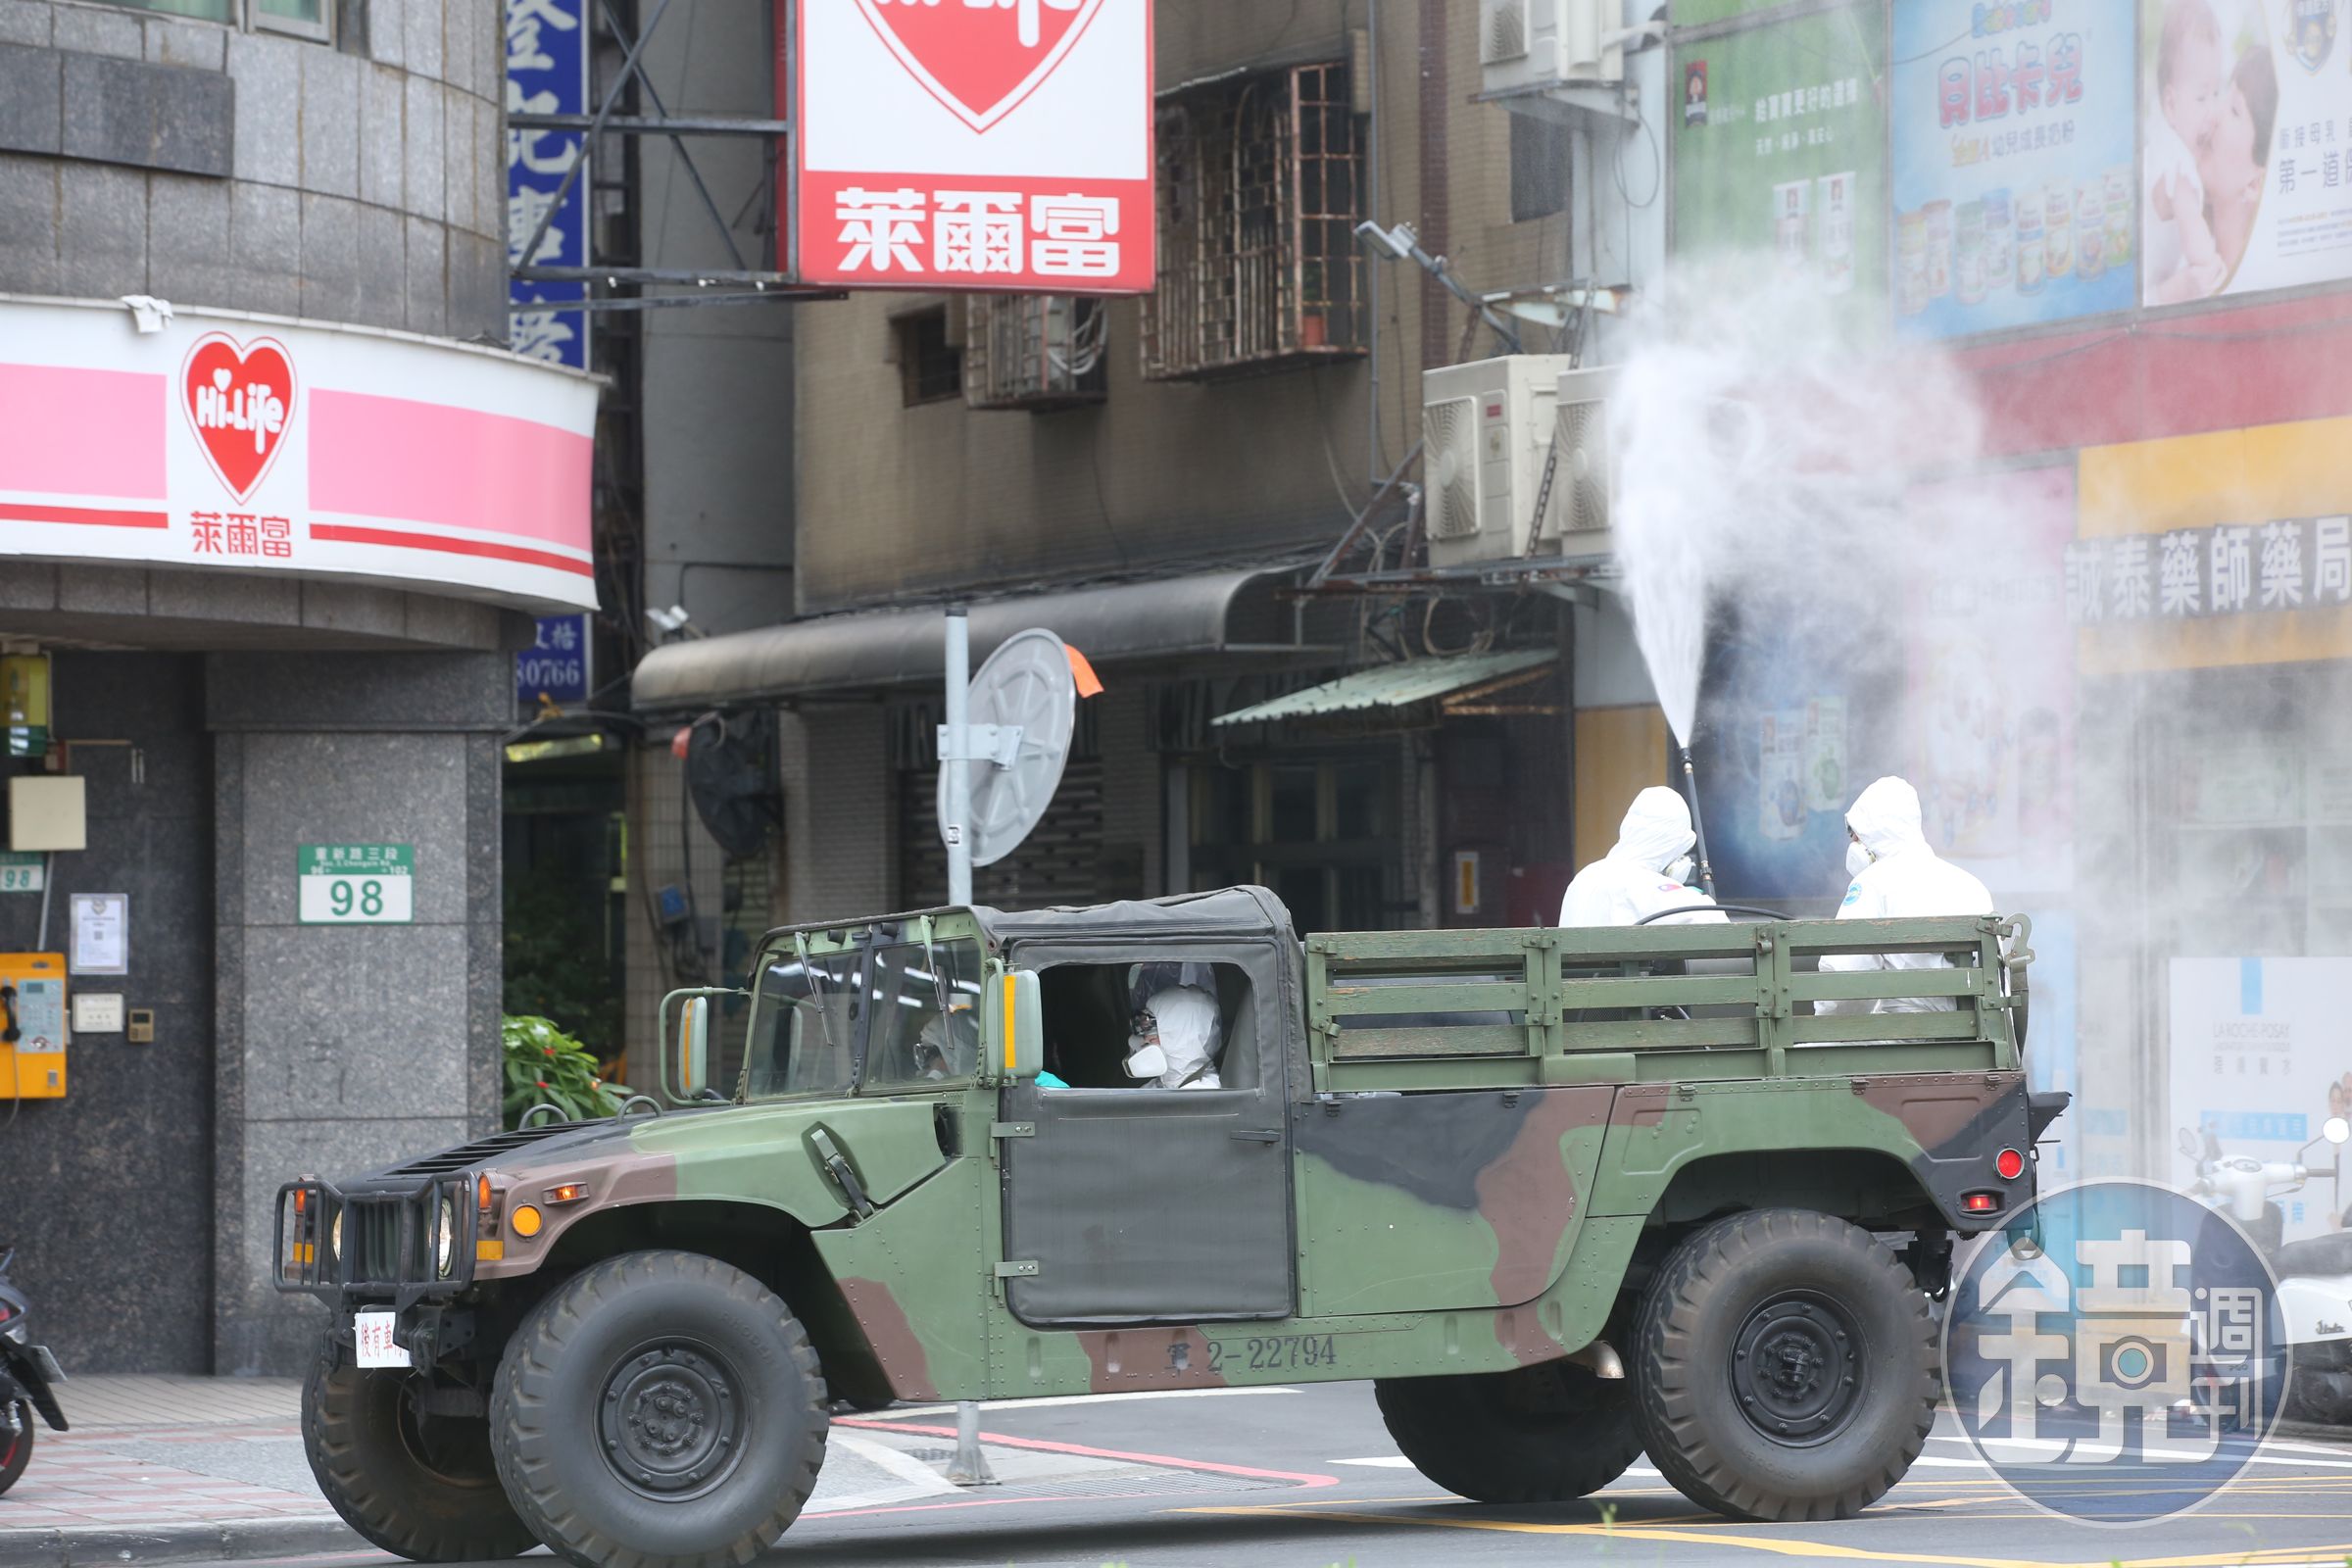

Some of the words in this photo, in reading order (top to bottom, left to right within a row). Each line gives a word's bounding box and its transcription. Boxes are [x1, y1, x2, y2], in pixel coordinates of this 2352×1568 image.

[1938, 32, 2084, 129] 貝比卡兒
[835, 186, 1120, 277] 萊爾富
[190, 511, 292, 558] 萊爾富
[2063, 515, 2352, 624] 誠泰藥師藥局
[6, 869, 30, 888] 98
[330, 880, 383, 916] 98
